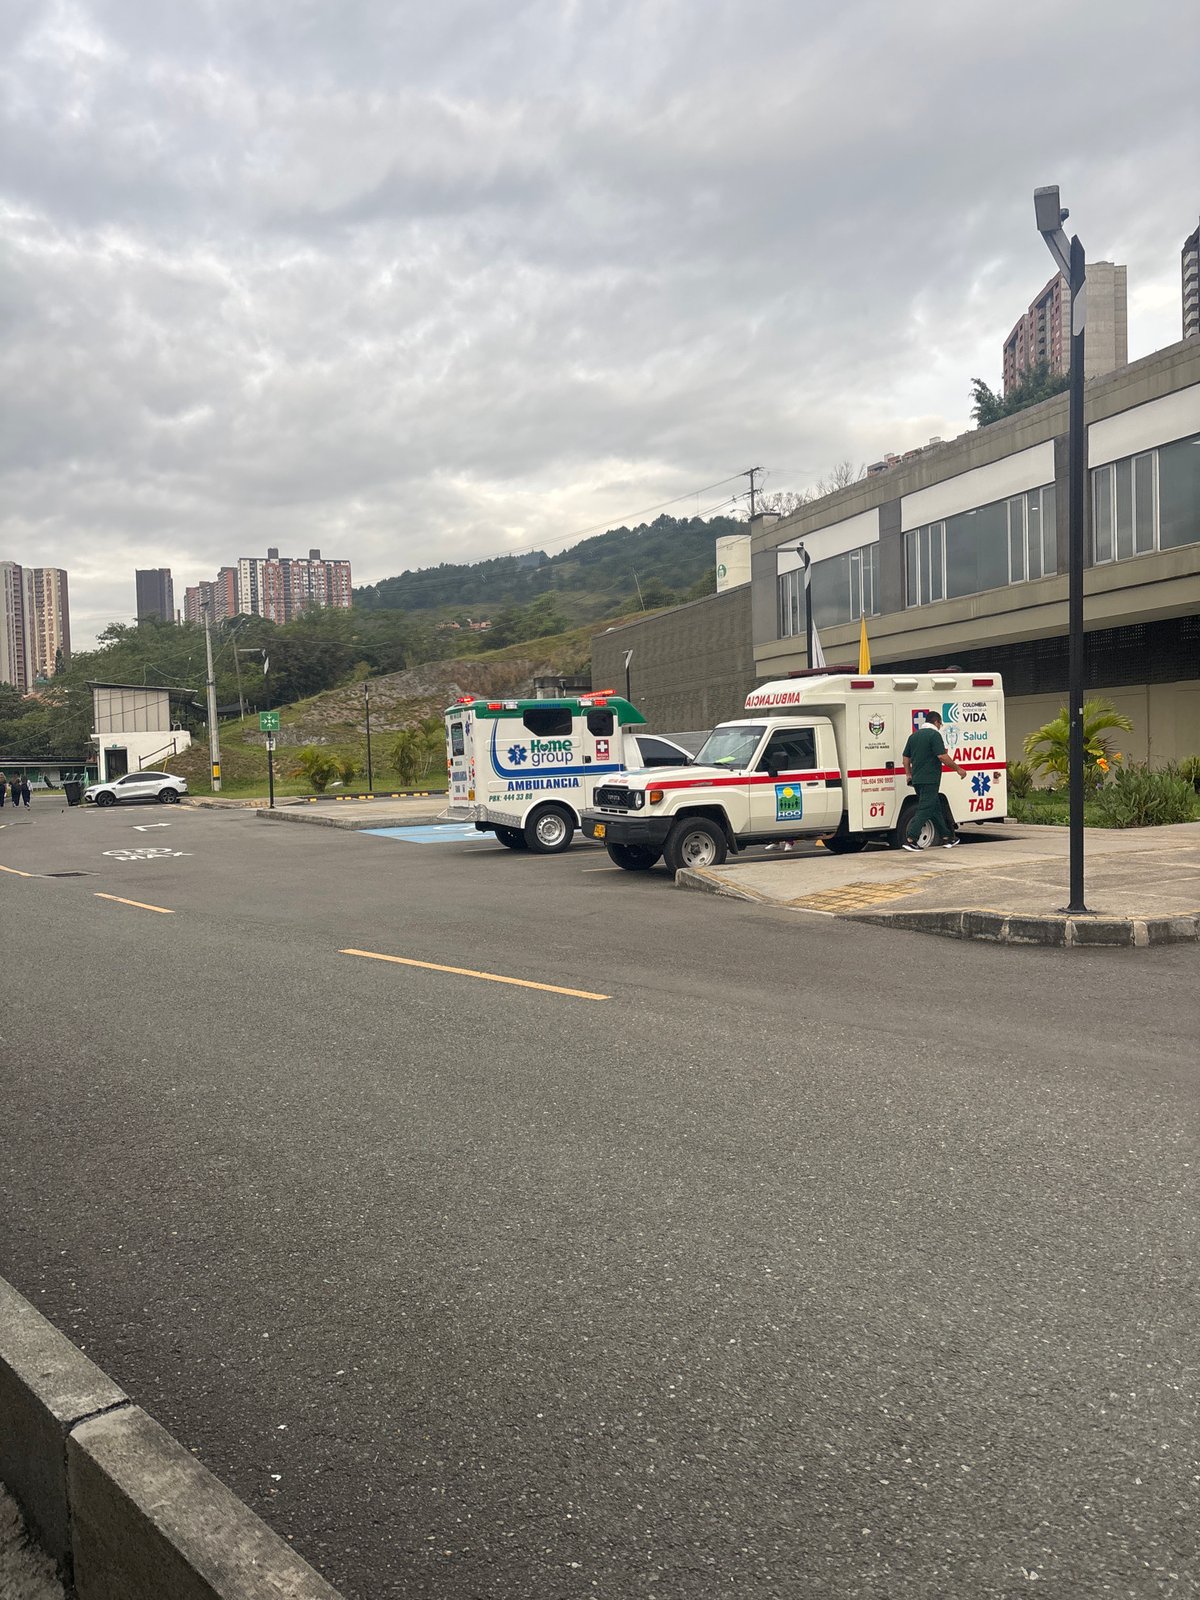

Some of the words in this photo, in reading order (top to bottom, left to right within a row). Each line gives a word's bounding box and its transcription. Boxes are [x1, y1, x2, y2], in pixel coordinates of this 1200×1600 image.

[962, 713, 987, 722] VIDA
[963, 731, 988, 741] Salud
[530, 739, 573, 753] Home
[531, 751, 573, 767] group
[507, 777, 580, 791] AMBULANCIA
[503, 793, 514, 801] 444
[968, 798, 994, 812] TAB
[870, 806, 884, 817] 01
